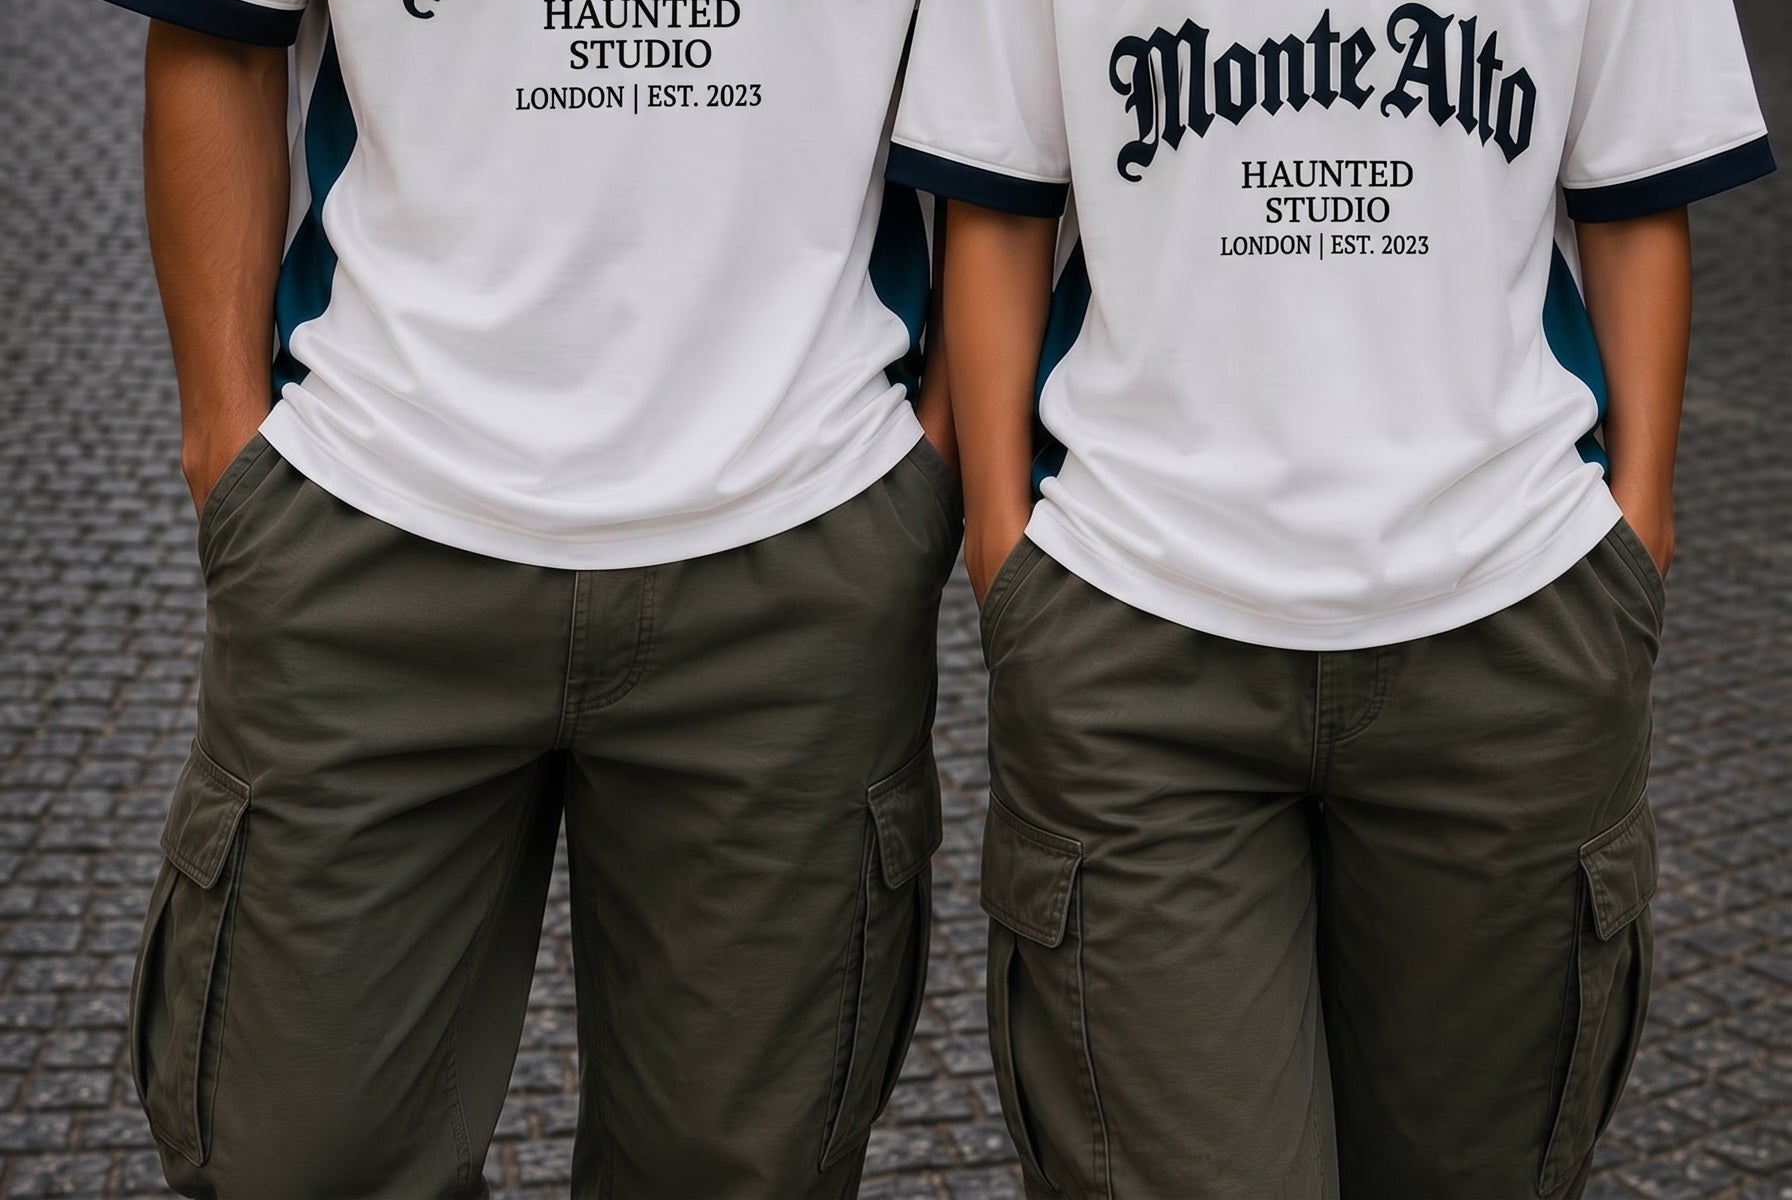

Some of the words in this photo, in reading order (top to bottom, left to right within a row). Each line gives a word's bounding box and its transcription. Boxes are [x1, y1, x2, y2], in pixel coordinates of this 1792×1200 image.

[569, 38, 712, 70] STUDIO
[515, 85, 625, 111] LONDON
[647, 84, 699, 108] EST.
[706, 83, 762, 108] 2023
[1108, 8, 1377, 183] Monte
[1380, 2, 1537, 165] Alto
[1241, 159, 1414, 189] HAUNTED
[1266, 196, 1390, 224] STUDIO
[1219, 234, 1312, 256] LONDON
[1330, 234, 1375, 255] EST.
[1381, 234, 1429, 255] 2023
